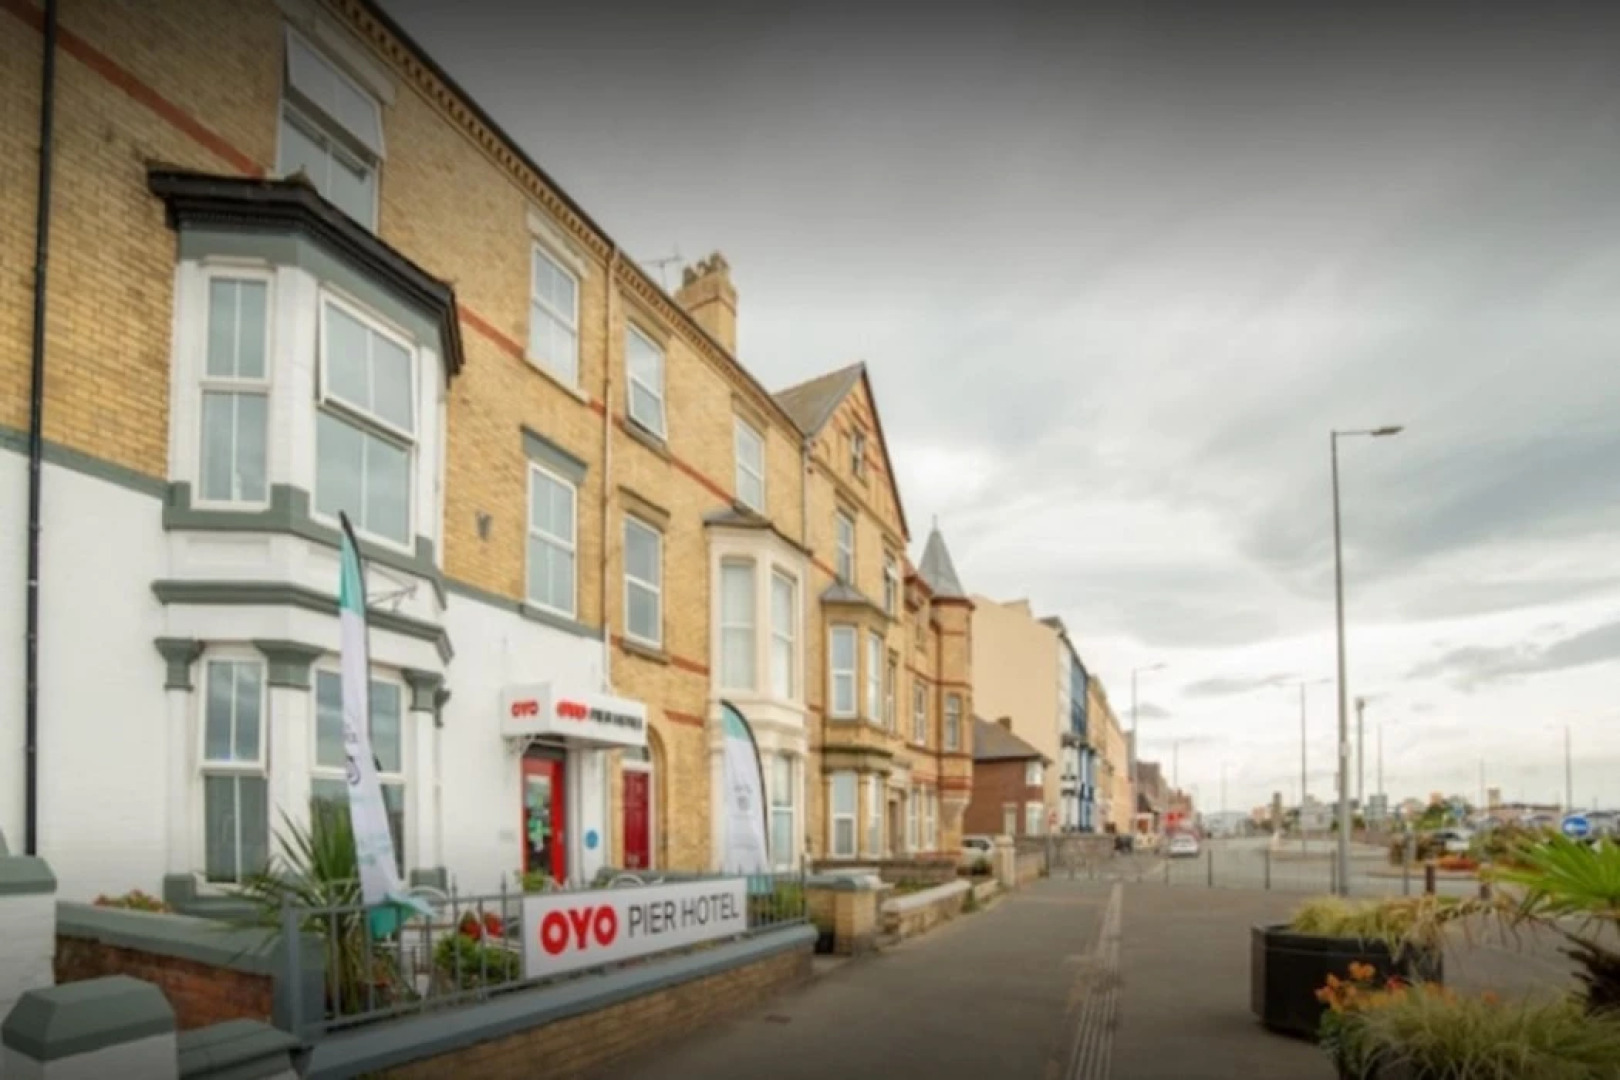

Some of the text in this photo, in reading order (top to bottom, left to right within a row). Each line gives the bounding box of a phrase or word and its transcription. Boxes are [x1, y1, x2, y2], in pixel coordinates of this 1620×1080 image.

[511, 700, 538, 717] OYO
[541, 893, 739, 954] OYO PIER HOTEL
